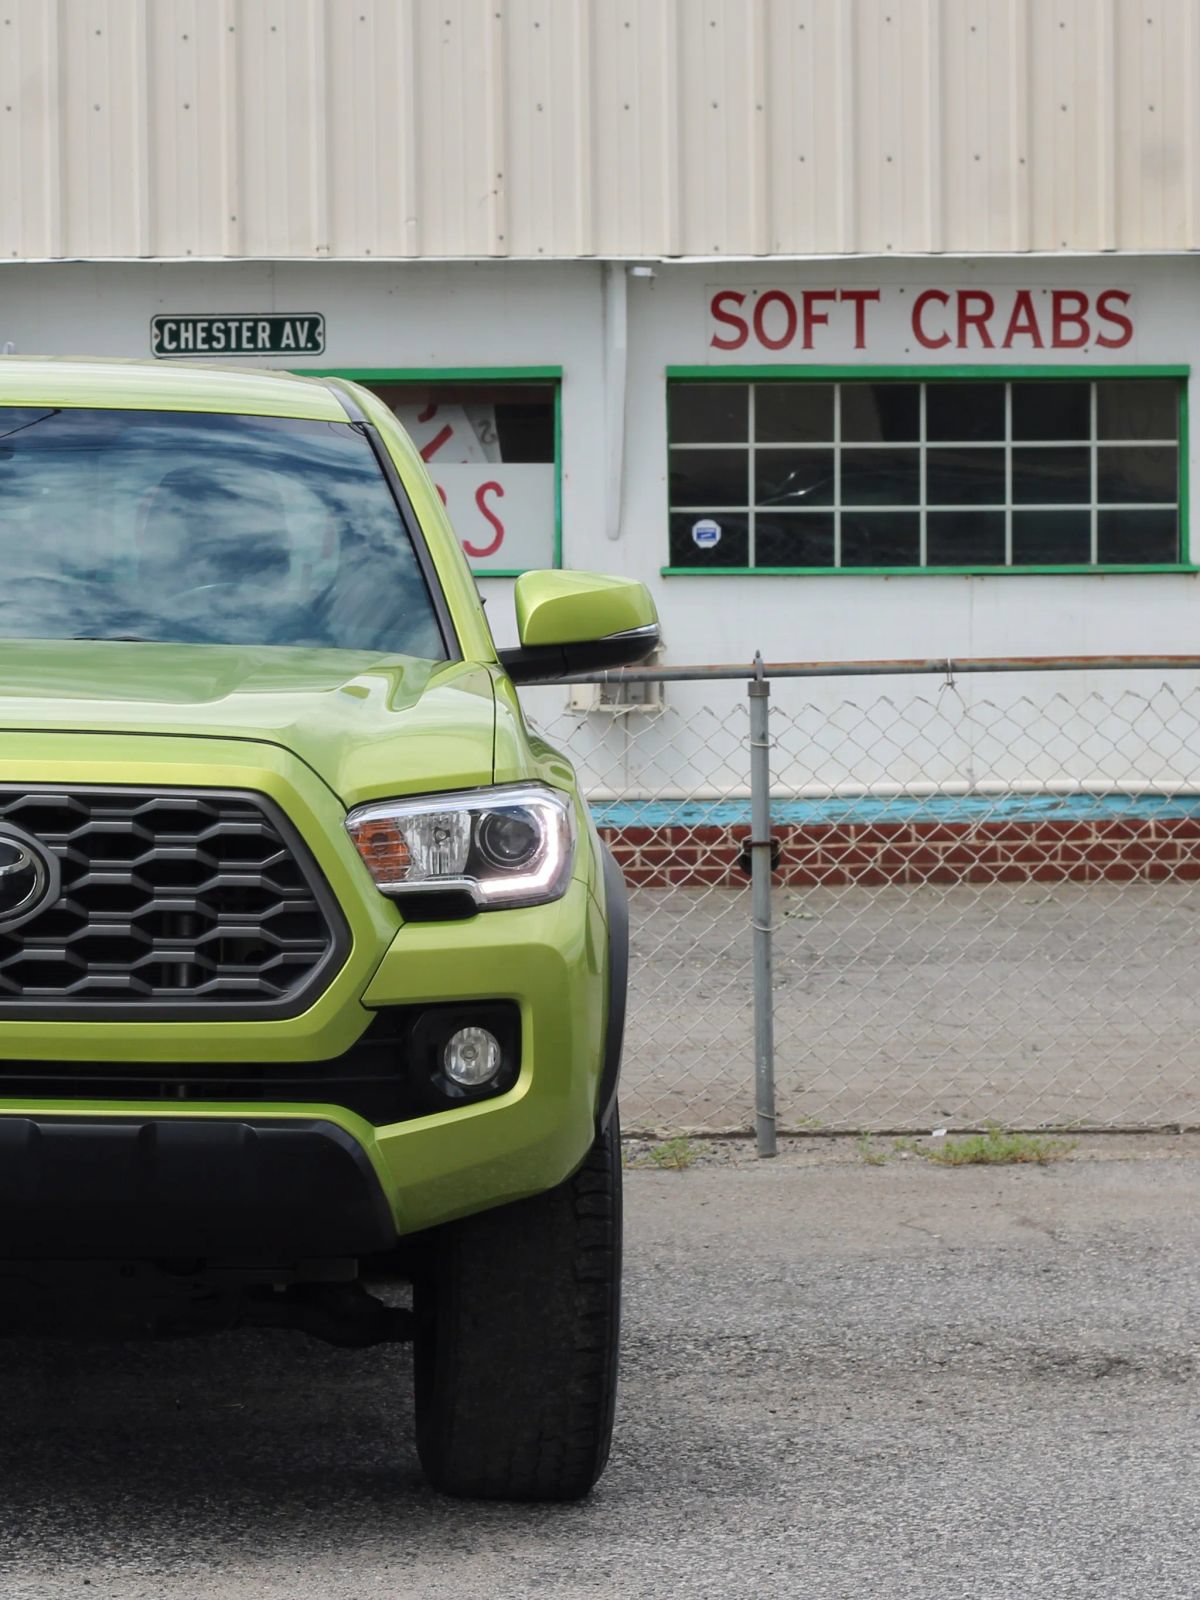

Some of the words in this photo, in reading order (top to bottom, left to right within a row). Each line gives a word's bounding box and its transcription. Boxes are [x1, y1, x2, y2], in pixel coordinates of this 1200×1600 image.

[163, 322, 271, 350] CHESTER
[280, 321, 313, 348] AV.
[709, 288, 880, 351] SOFT
[911, 288, 1134, 350] CRABS
